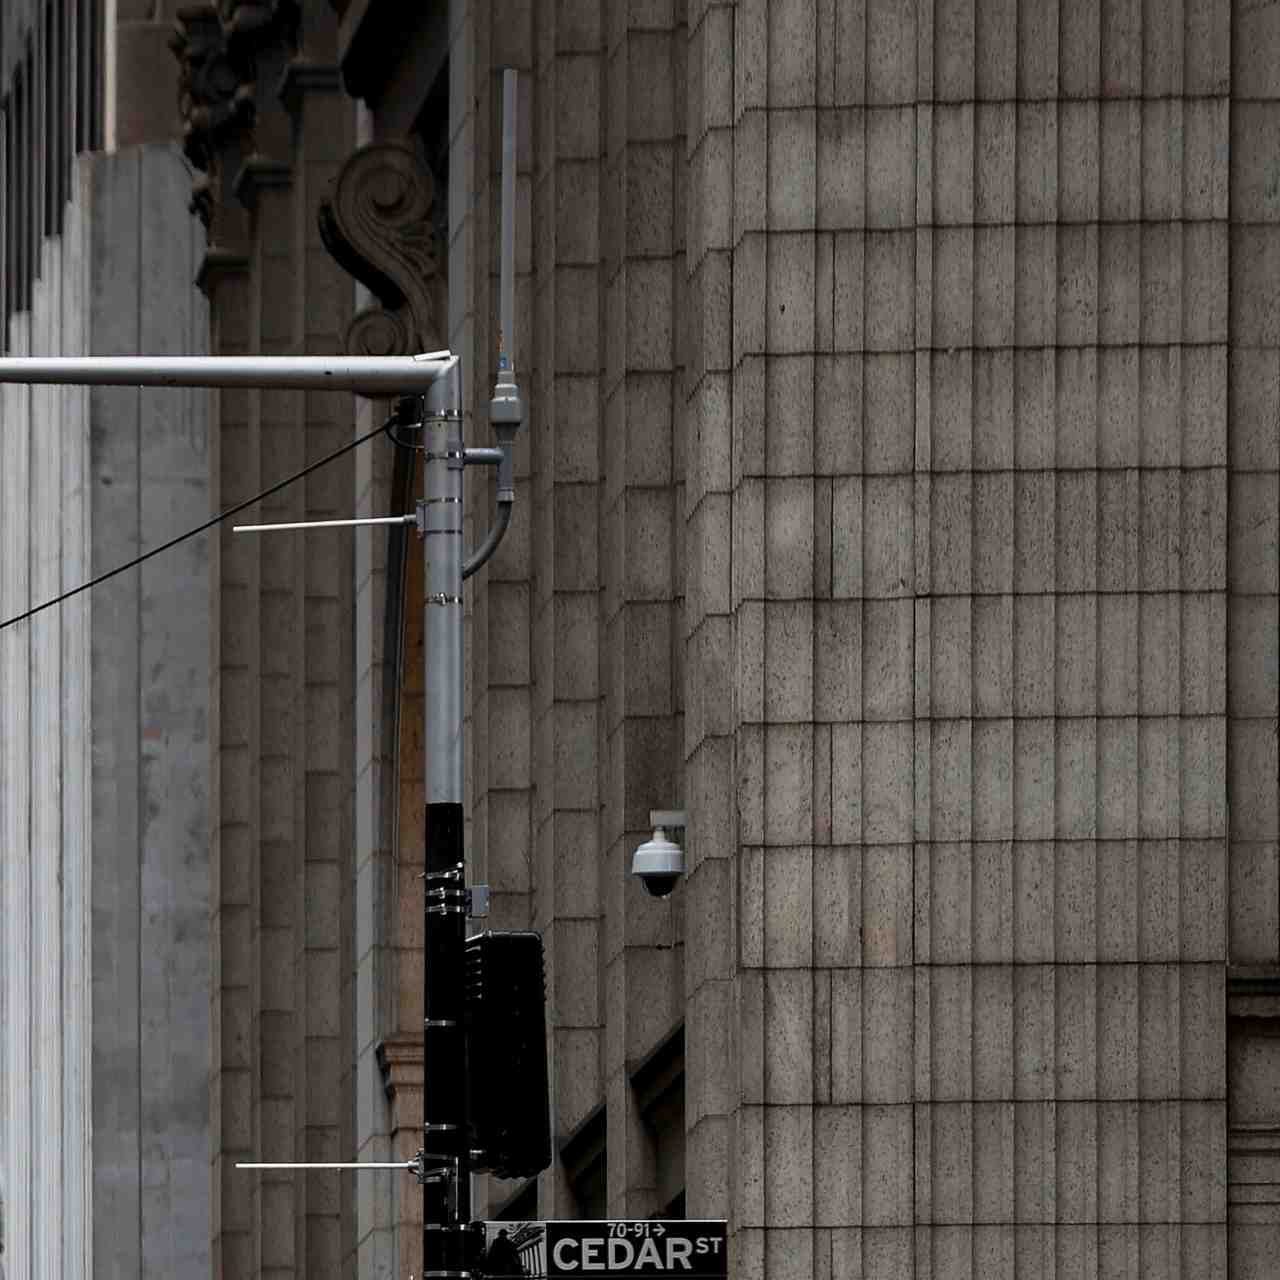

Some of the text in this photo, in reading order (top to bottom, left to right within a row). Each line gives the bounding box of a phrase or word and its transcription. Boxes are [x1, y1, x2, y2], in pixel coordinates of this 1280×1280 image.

[607, 1223, 650, 1238] 70-91
[553, 1237, 723, 1271] CEDAR ST
